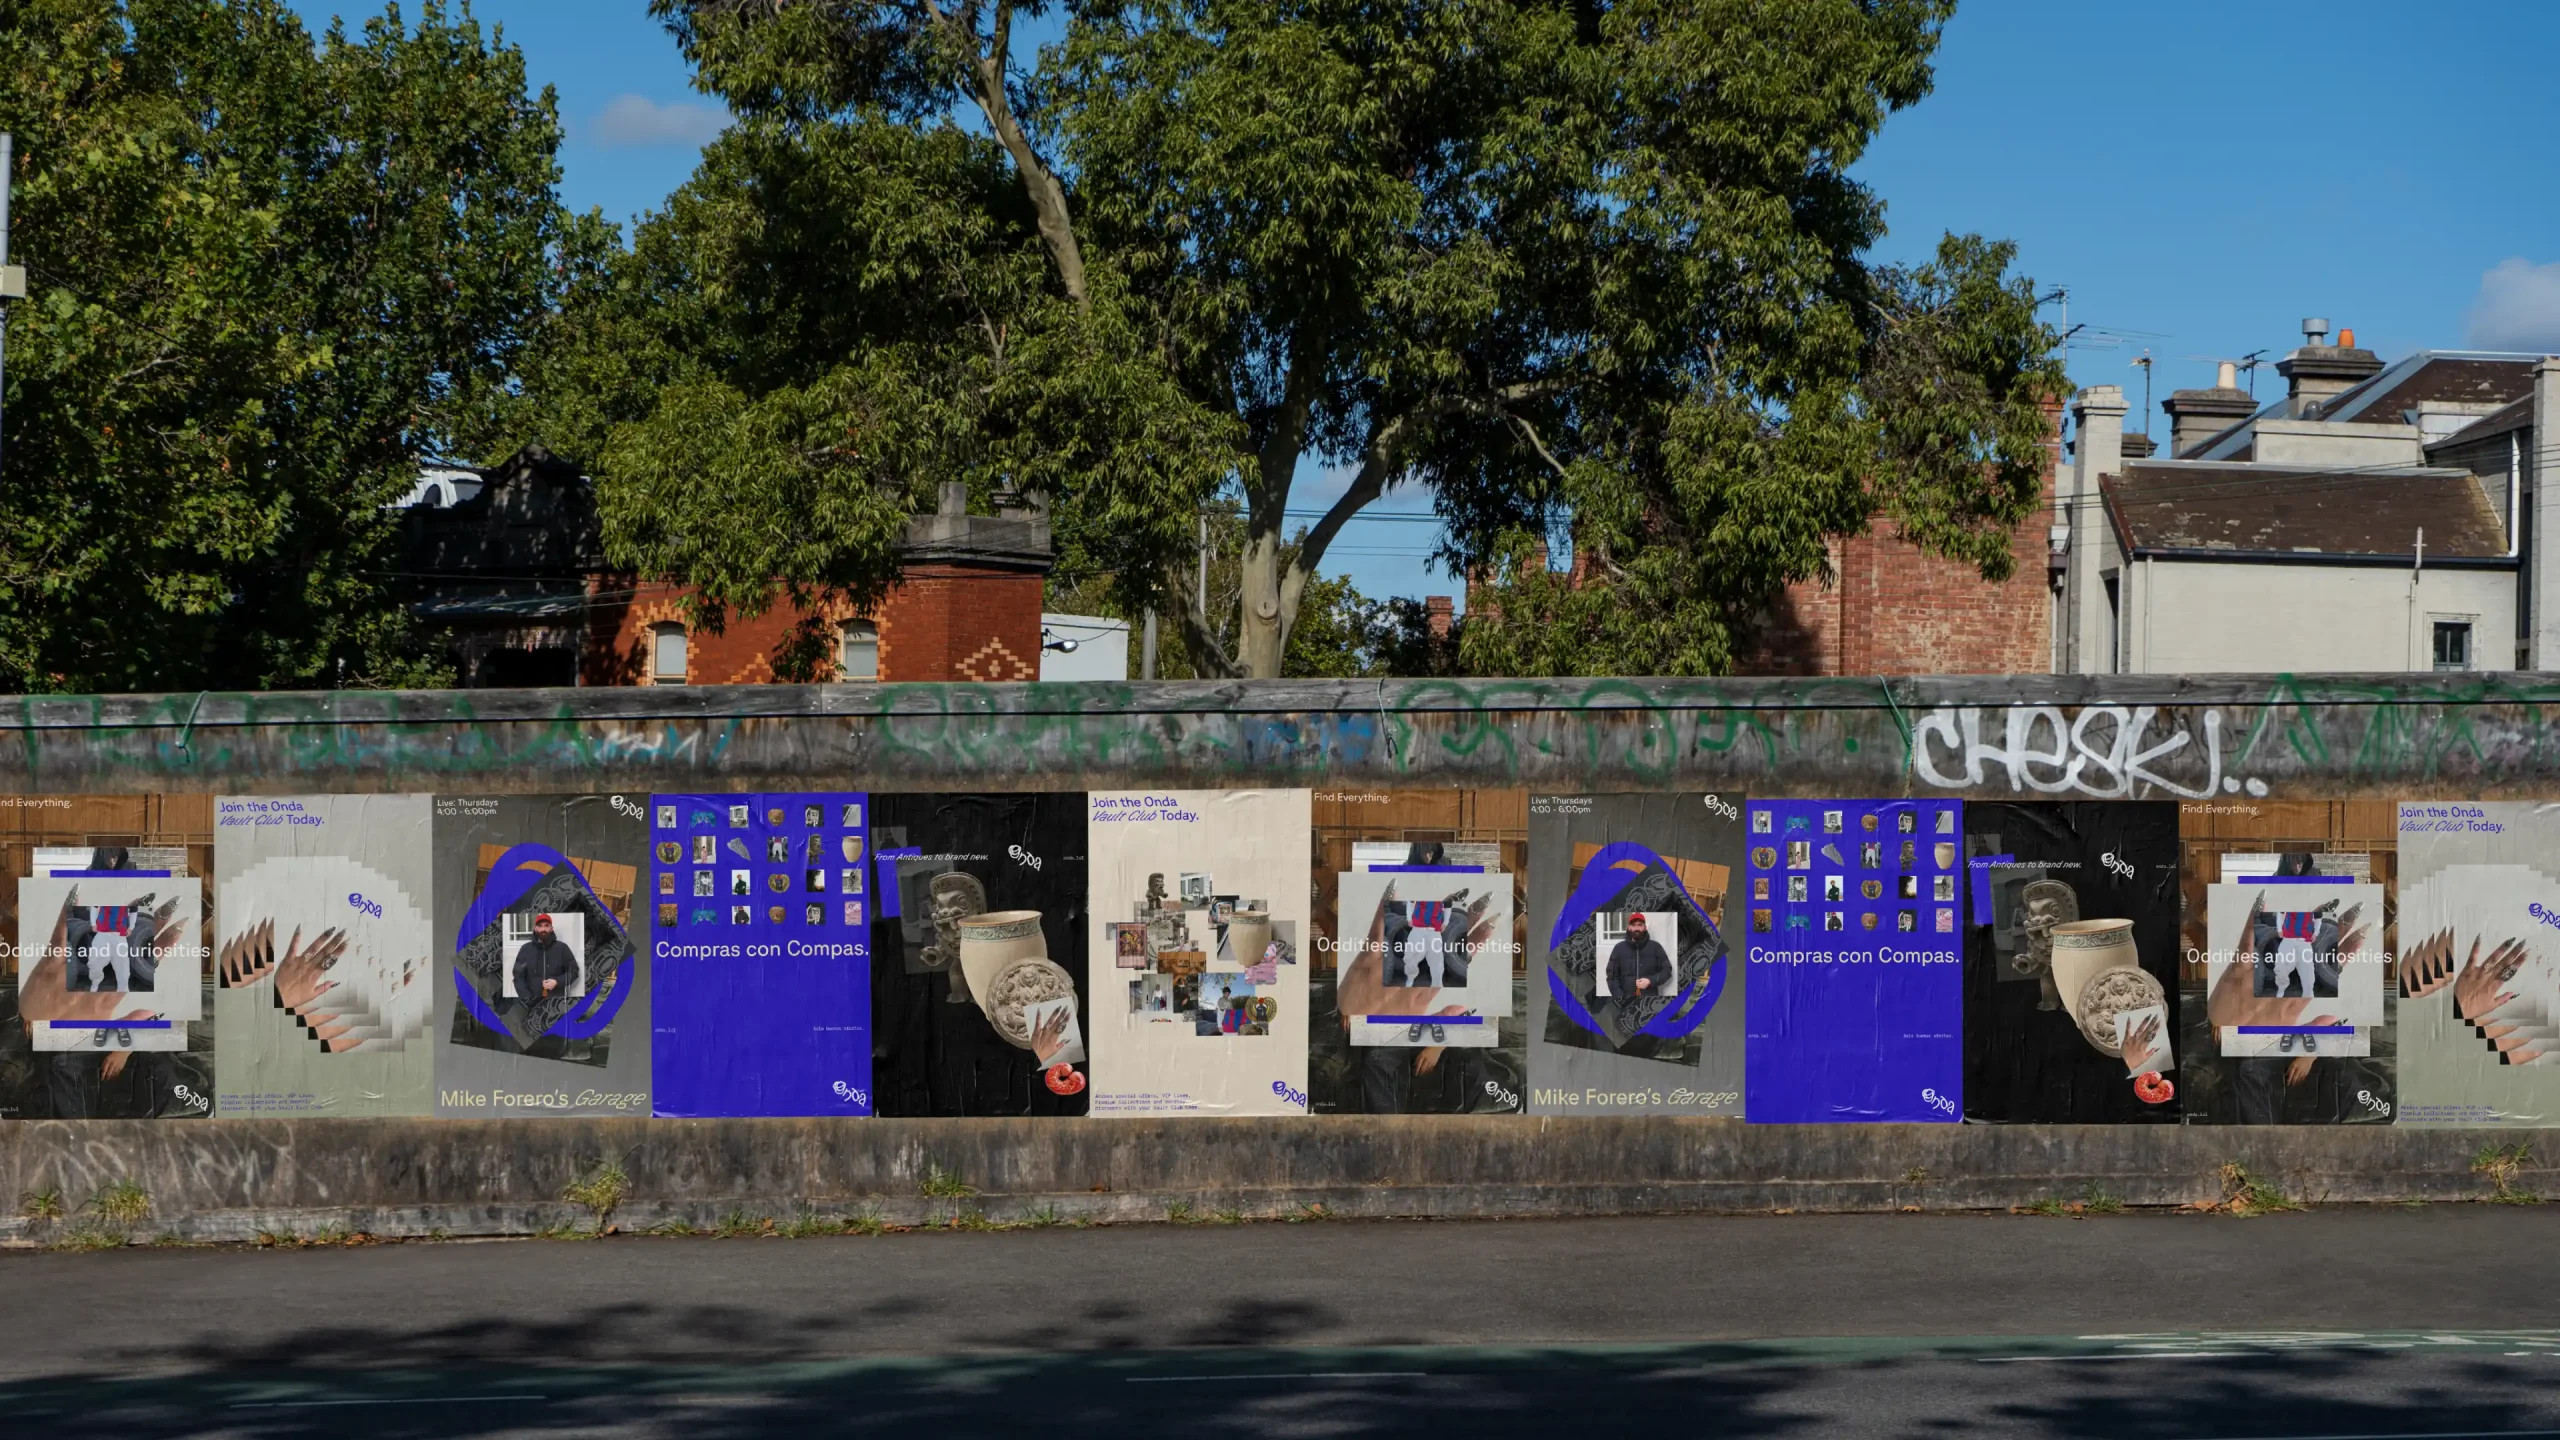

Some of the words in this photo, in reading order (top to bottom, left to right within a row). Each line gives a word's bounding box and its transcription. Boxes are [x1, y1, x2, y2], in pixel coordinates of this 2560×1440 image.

[17, 798, 72, 809] Everything.
[458, 799, 499, 807] Thursdays
[1092, 797, 1117, 807] Join
[1119, 797, 1141, 807] the
[1144, 797, 1178, 808] Onda
[1314, 793, 1335, 802] Find
[1337, 793, 1391, 803] Everything.
[1552, 797, 1592, 805] Thursdays
[220, 801, 245, 811] Join
[247, 801, 268, 811] the
[271, 801, 303, 812] Onda
[437, 807, 457, 815] 4:00
[464, 807, 497, 816] 6:00pm
[1531, 805, 1551, 813] 4:00
[1558, 805, 1591, 814] 6:00pm
[2182, 804, 2203, 814] Find
[2205, 804, 2259, 815] Everything.
[1092, 810, 1126, 821] Vault
[1128, 810, 1157, 821] Club
[1160, 810, 1199, 822] Today.
[2400, 807, 2424, 817] Join
[2426, 807, 2448, 817] the
[2451, 807, 2484, 818] Onda
[219, 814, 253, 825] Vault
[255, 814, 283, 825] Club
[287, 814, 325, 826] Today.
[2400, 820, 2433, 832] Vault
[2435, 820, 2464, 831] Club
[2467, 820, 2505, 832] Today.
[896, 853, 933, 862] Antiques
[934, 853, 943, 861] to
[945, 853, 969, 861] brand
[969, 853, 989, 861] new.
[1989, 860, 2026, 869] Antiques
[2028, 860, 2036, 868] to
[2038, 860, 2062, 868] brand
[0, 942, 72, 958] Oddities
[77, 942, 111, 958] and
[116, 942, 210, 958] Curiosities
[655, 940, 740, 960] Compras
[746, 942, 780, 957] con
[787, 940, 869, 959] Compas.
[1317, 936, 1389, 953] Oddities
[1394, 937, 1427, 953] and
[1431, 937, 1521, 954] Curiosities
[1749, 946, 1833, 966] Compras
[1838, 949, 1873, 963] con
[1878, 946, 1960, 966] Compas.
[2187, 948, 2259, 964] Oddities
[2265, 948, 2298, 964] and
[2301, 948, 2392, 964] Curiosities
[441, 1090, 486, 1107] Mike
[493, 1089, 568, 1107] Forero's
[575, 1089, 646, 1110] Garage
[1534, 1088, 1580, 1106] Mike
[1586, 1088, 1661, 1106] Forero's
[1667, 1088, 1738, 1108] Garage
